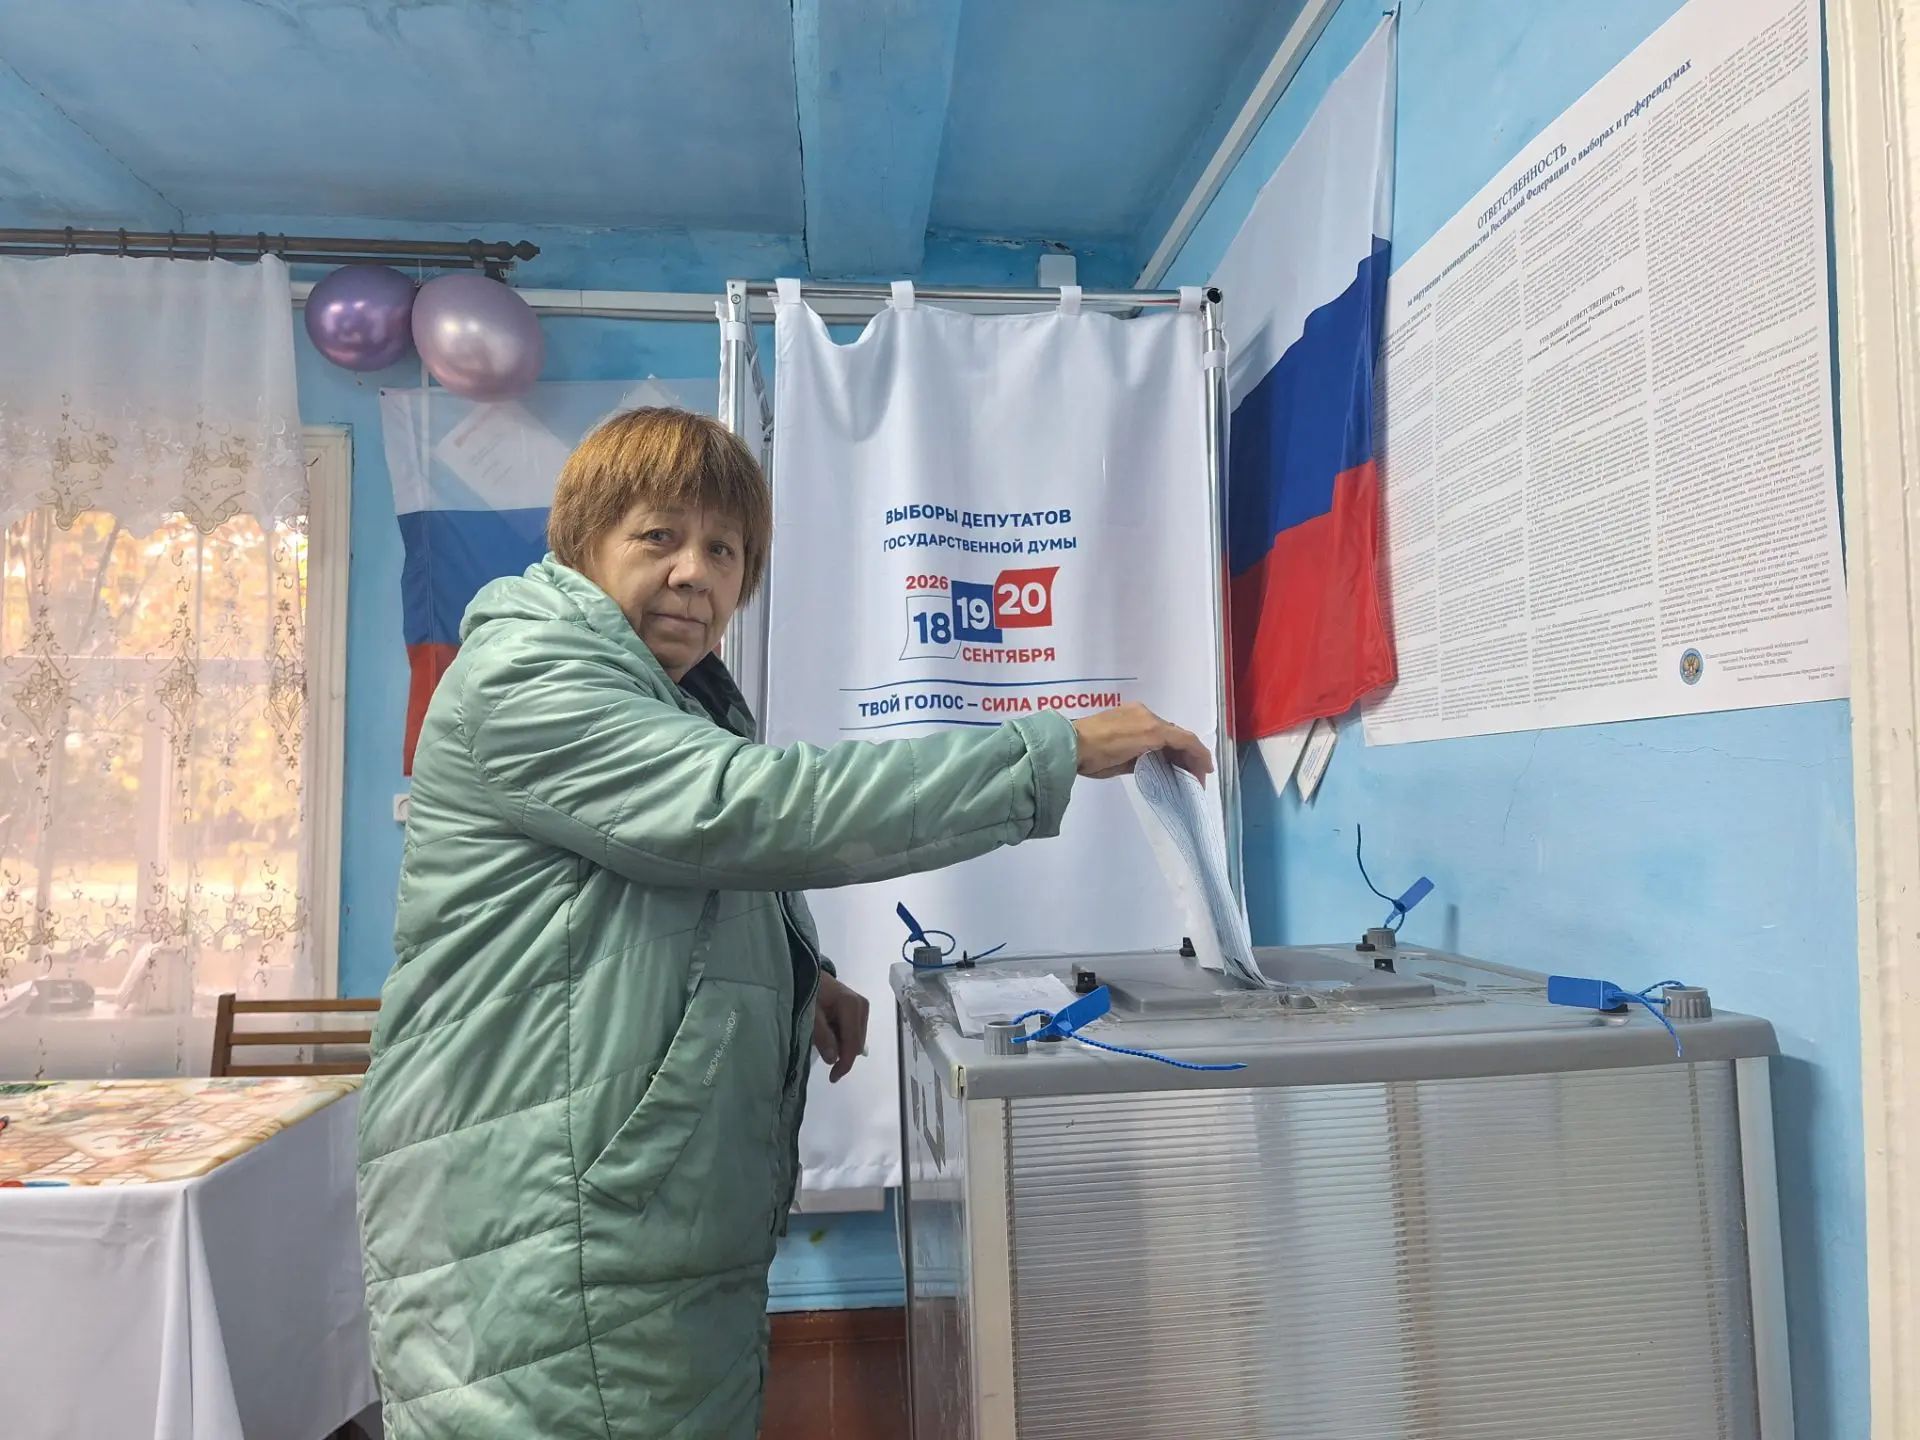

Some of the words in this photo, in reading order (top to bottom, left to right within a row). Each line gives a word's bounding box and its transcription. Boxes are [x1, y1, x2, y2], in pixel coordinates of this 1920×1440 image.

[1490, 196, 1526, 235] Российской
[1526, 161, 1570, 201] Федерации
[1570, 157, 1577, 166] о
[1578, 124, 1615, 161] выборах
[1616, 118, 1622, 130] и
[1623, 59, 1692, 127] референдумах
[1477, 143, 1567, 229] ОТВЕТСТВЕННОСТЬ
[886, 504, 958, 525] ВЫБОРЫ
[961, 509, 1072, 528] ДЕПУТАТОВ
[883, 533, 1023, 554] ГОСУДАРСТВЕННОЙ
[1027, 537, 1077, 554] ДУМЫ
[906, 575, 949, 590] 2026
[913, 612, 952, 644] 18
[956, 597, 991, 631] 19
[998, 582, 1047, 615] 20
[962, 647, 1056, 664] СЕНТЯБРЯ
[859, 694, 900, 717] ТВОЙ
[905, 694, 964, 711] ГОЛОС
[982, 696, 1032, 712] СИЛА
[1037, 693, 1121, 711] РОССИИ!
